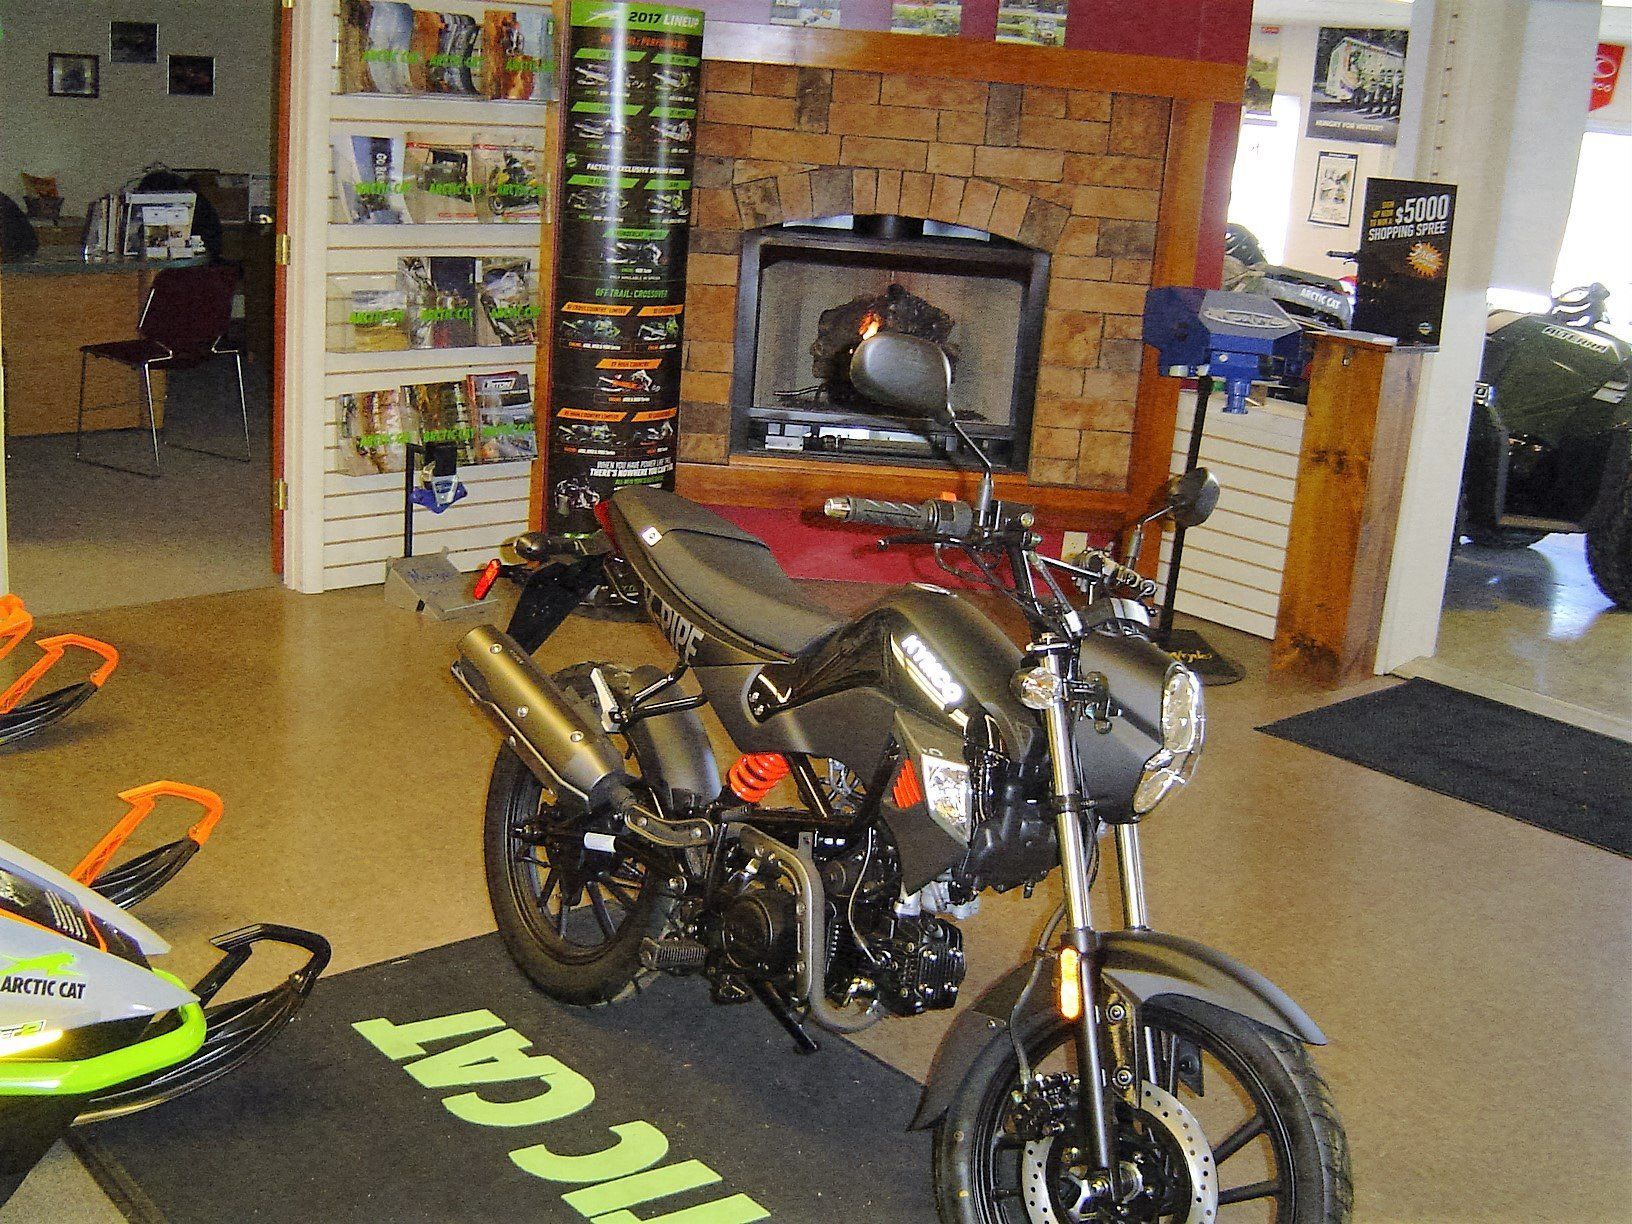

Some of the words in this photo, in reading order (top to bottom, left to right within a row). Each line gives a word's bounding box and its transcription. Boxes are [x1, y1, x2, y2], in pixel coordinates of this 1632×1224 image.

[629, 11, 662, 23] 2017
[663, 14, 699, 28] LINEUP
[1396, 195, 1448, 225] $5000
[1368, 225, 1414, 241] SHOPPING
[1416, 220, 1448, 237] SPREE
[1301, 288, 1327, 305] ARCTIC
[1327, 294, 1342, 310] CAT
[1541, 326, 1608, 353] ALTERRA
[590, 467, 617, 477] THERE'S
[618, 467, 648, 477] NOWHERE
[1, 975, 56, 997] ARCTIC
[59, 980, 86, 1000] CAT
[351, 1008, 596, 1127] CAT
[509, 1120, 771, 1224] TIC
